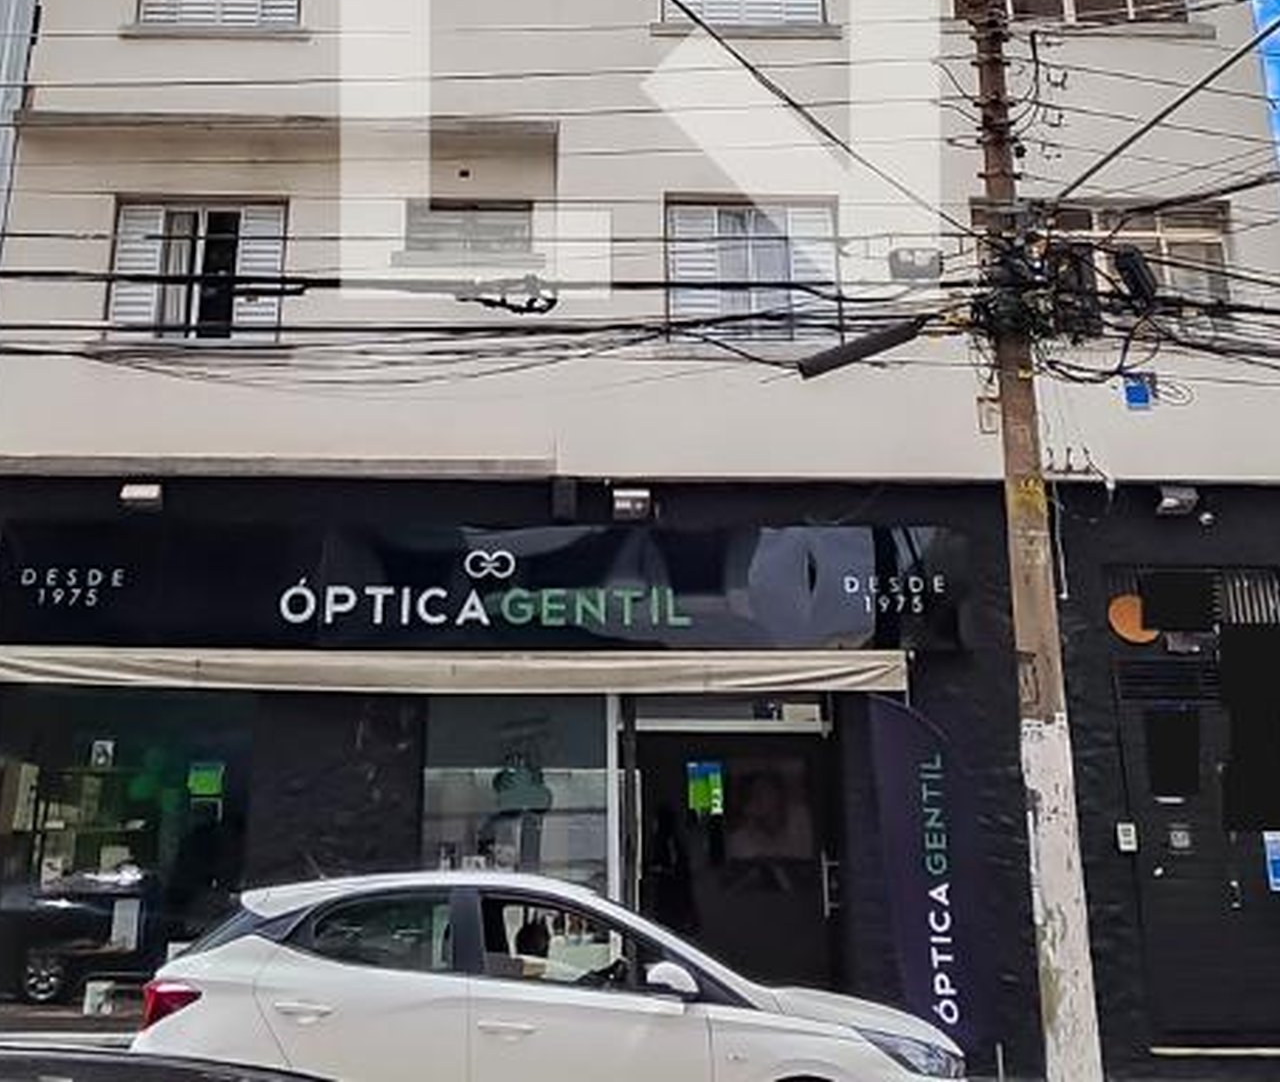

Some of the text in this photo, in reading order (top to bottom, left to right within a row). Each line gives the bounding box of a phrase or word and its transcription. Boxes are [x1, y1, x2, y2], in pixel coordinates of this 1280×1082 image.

[20, 567, 125, 587] DESDE
[843, 575, 945, 594] DESDE
[37, 587, 98, 607] 1975
[278, 577, 692, 627] ÓPTICA GENTIL
[920, 752, 960, 1026] ÓPTICA GENTIL
